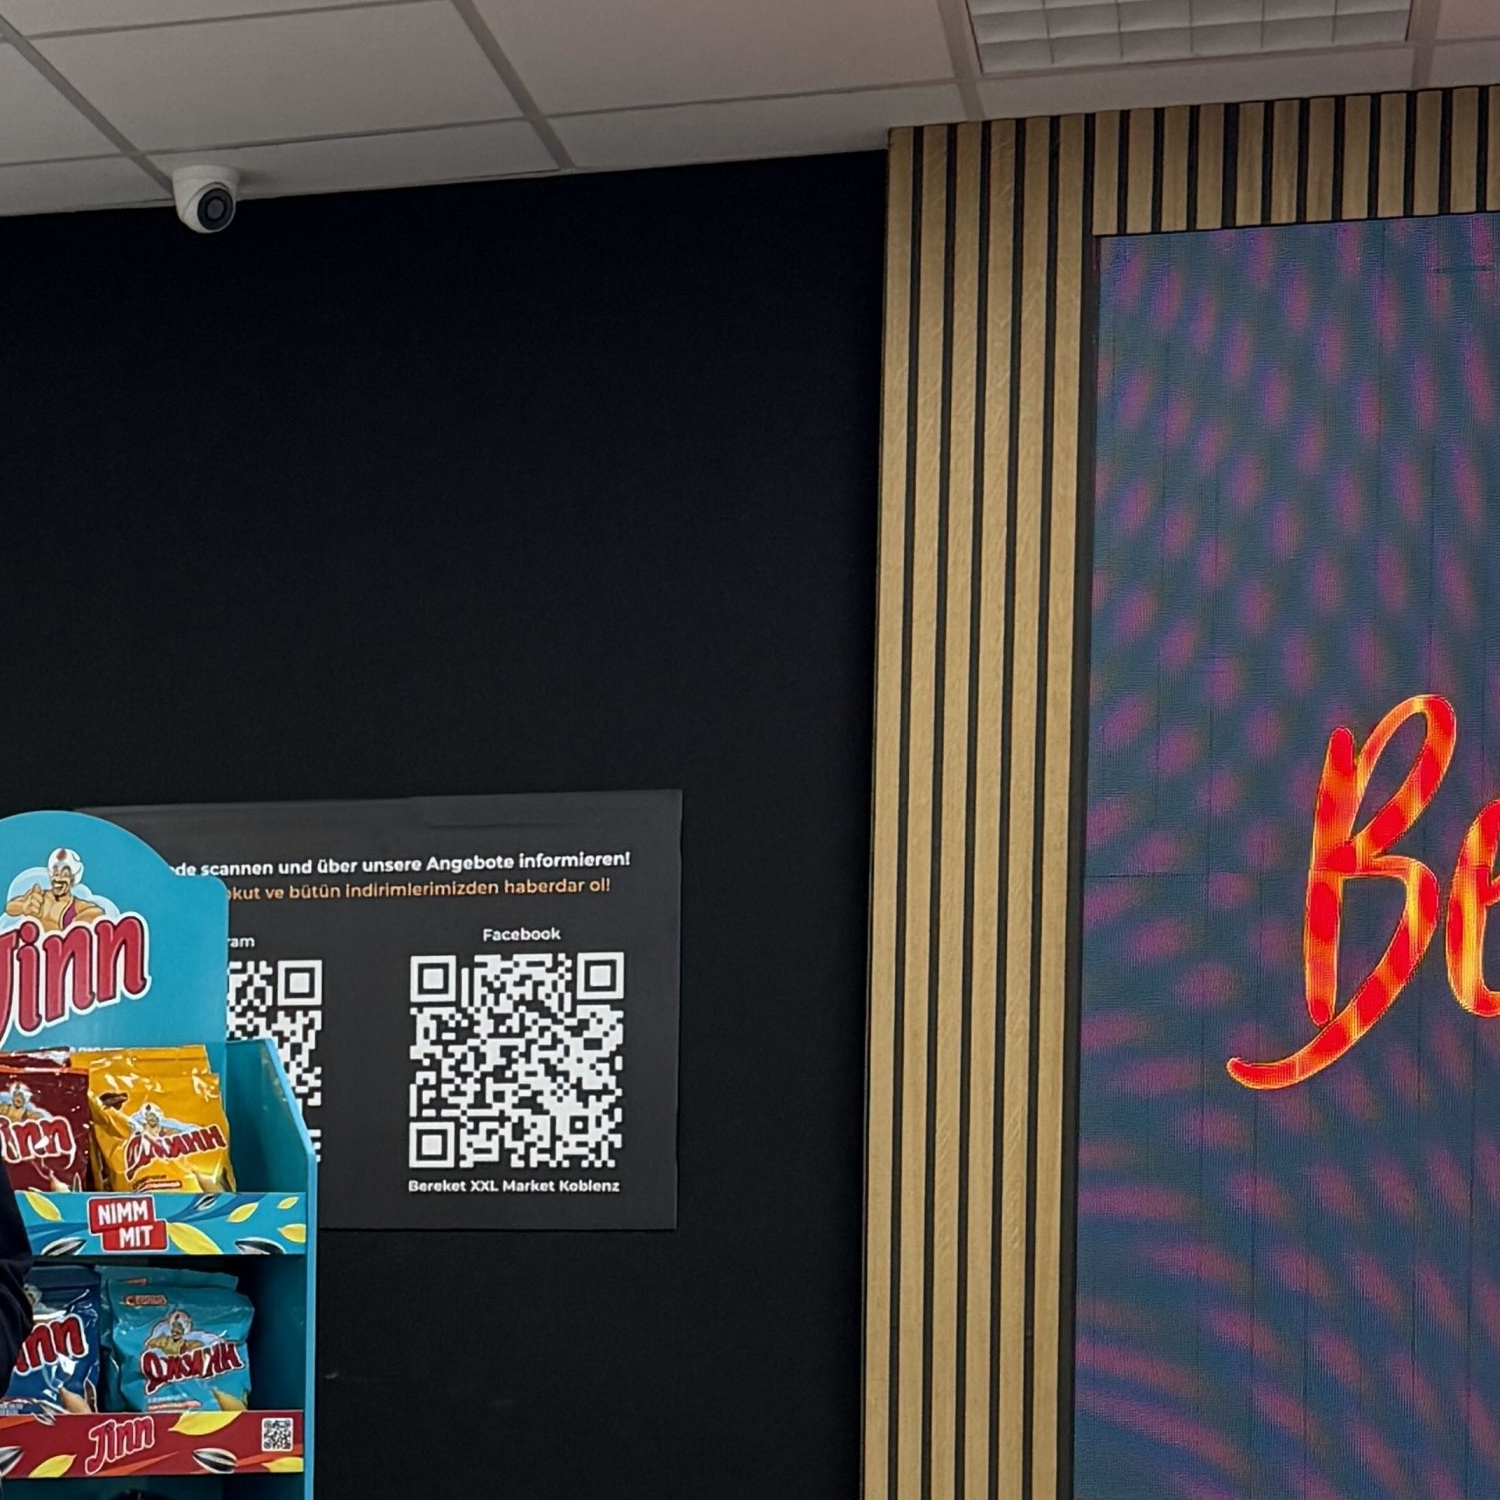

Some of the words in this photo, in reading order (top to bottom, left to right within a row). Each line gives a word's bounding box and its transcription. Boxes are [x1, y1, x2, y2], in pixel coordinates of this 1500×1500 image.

[172, 863, 197, 876] de
[200, 864, 274, 876] scannen
[278, 860, 312, 875] und
[317, 859, 358, 874] über
[362, 858, 422, 873] unsere
[426, 855, 514, 874] Angebote
[519, 851, 631, 869] informieren!
[265, 889, 284, 899] ve
[289, 883, 341, 899] bütün
[345, 880, 499, 898] indirimlerimizden
[504, 878, 585, 894] haberdar
[589, 877, 610, 892] ol!
[227, 937, 255, 948] ram
[483, 926, 561, 942] Facebook
[408, 1179, 467, 1192] Bereket
[470, 1180, 499, 1192] XXL
[502, 1180, 555, 1192] Market
[559, 1179, 620, 1192] Koblenz
[98, 1201, 148, 1225] NIMM
[119, 1225, 153, 1247] MIT
[86, 1416, 155, 1474] Jinn
